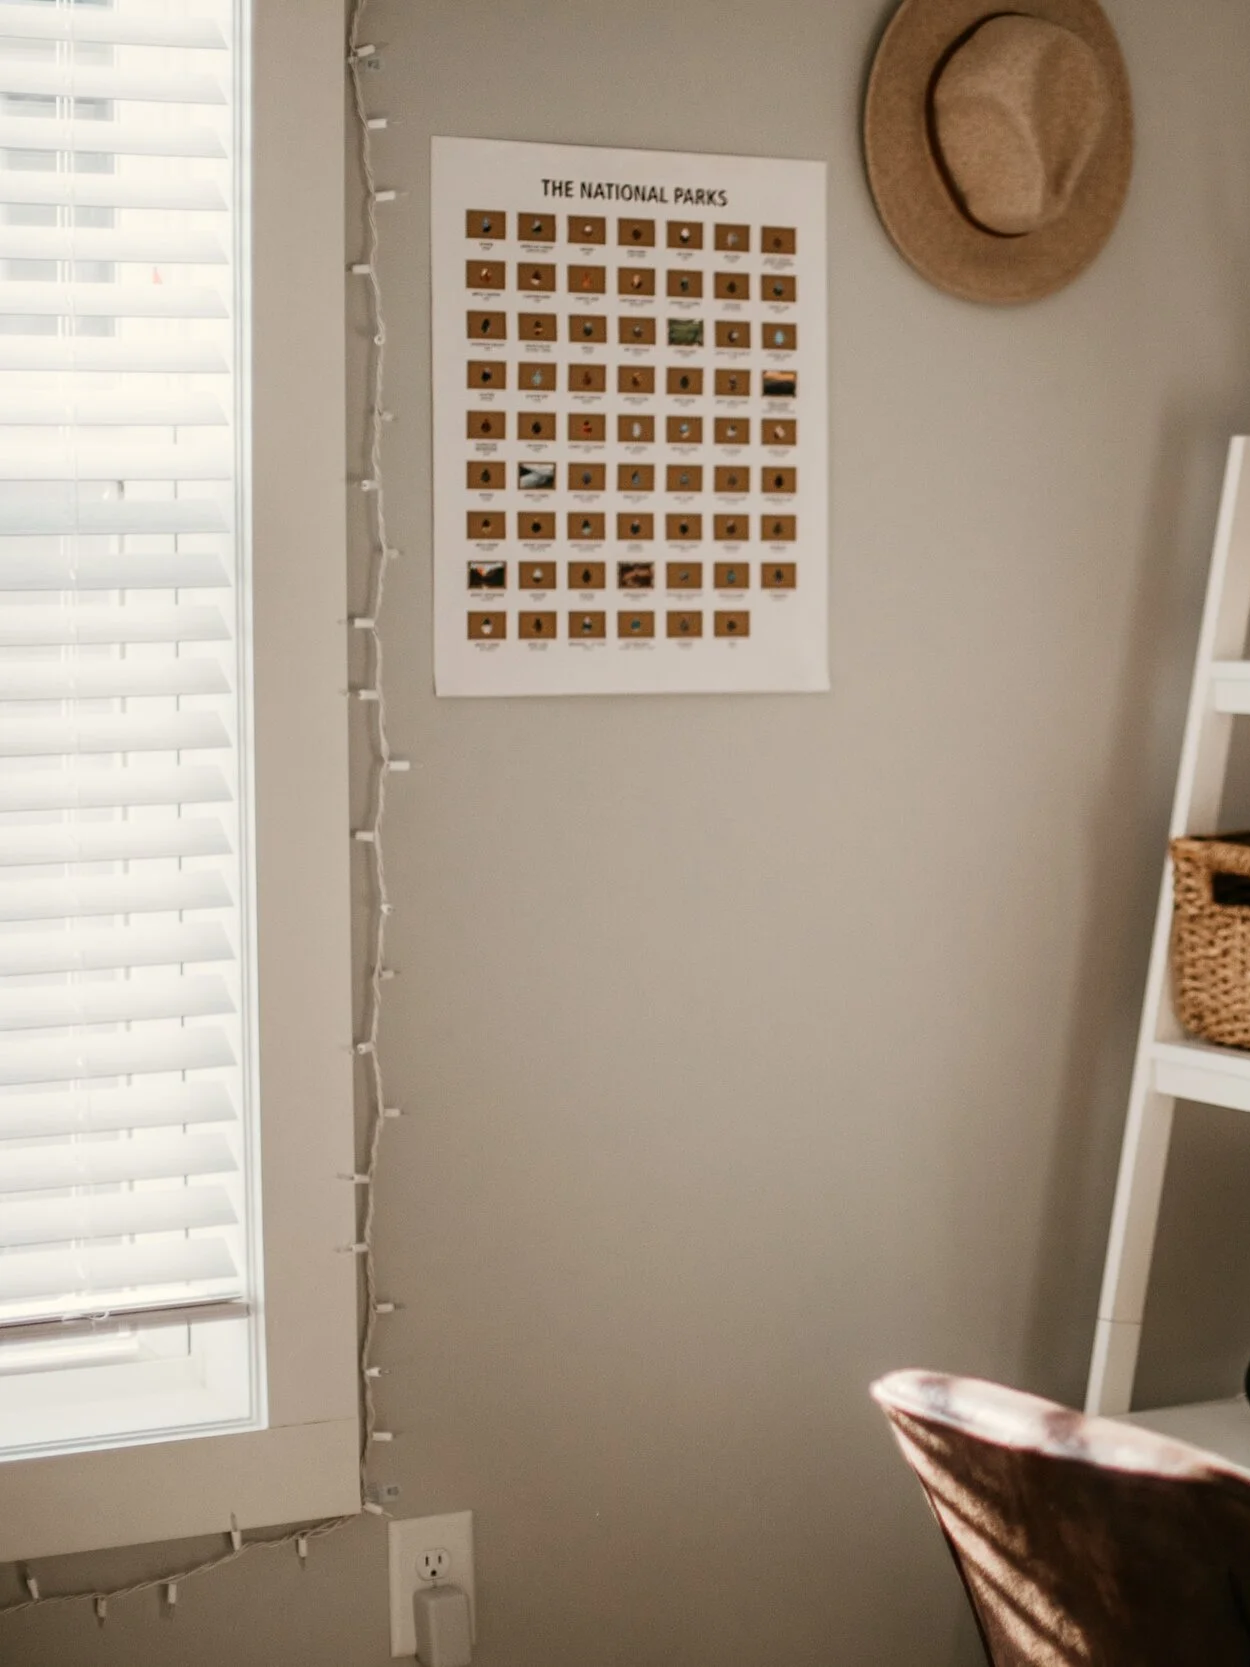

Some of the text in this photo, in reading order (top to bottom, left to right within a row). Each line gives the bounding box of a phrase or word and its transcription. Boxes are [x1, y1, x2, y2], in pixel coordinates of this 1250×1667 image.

[541, 178, 729, 208] THE NATIONAL PARKS
